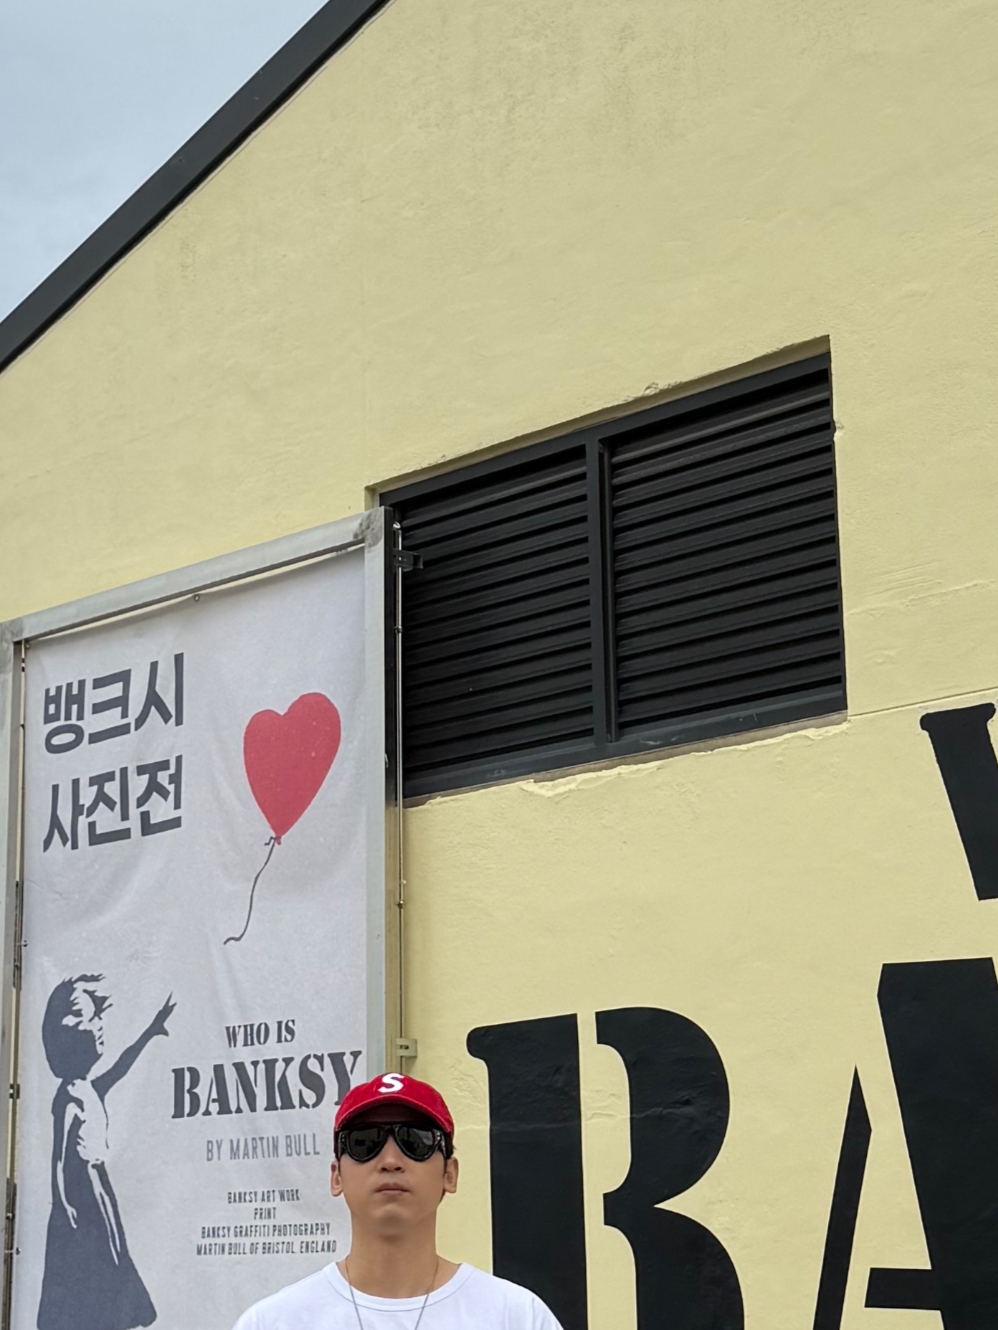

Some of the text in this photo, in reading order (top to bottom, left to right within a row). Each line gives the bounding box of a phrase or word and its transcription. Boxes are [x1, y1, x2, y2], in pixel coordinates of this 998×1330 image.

[43, 652, 185, 755] 뱅크시
[43, 754, 183, 853] 사진전
[225, 1019, 296, 1049] WHO IS
[171, 1050, 362, 1119] BANKSY
[377, 1072, 405, 1093] S
[206, 1133, 320, 1162] BY MARTIN BULL
[227, 1188, 300, 1204] BANKSY ART WORK
[254, 1207, 277, 1220] PRINT
[201, 1222, 331, 1239] BANKSY GRAFFITI PHOTOGRAPHY
[196, 1243, 226, 1256] MARTIN
[228, 1242, 248, 1255] BULL
[250, 1242, 260, 1255] OF
[299, 1239, 337, 1254] ENGLAND
